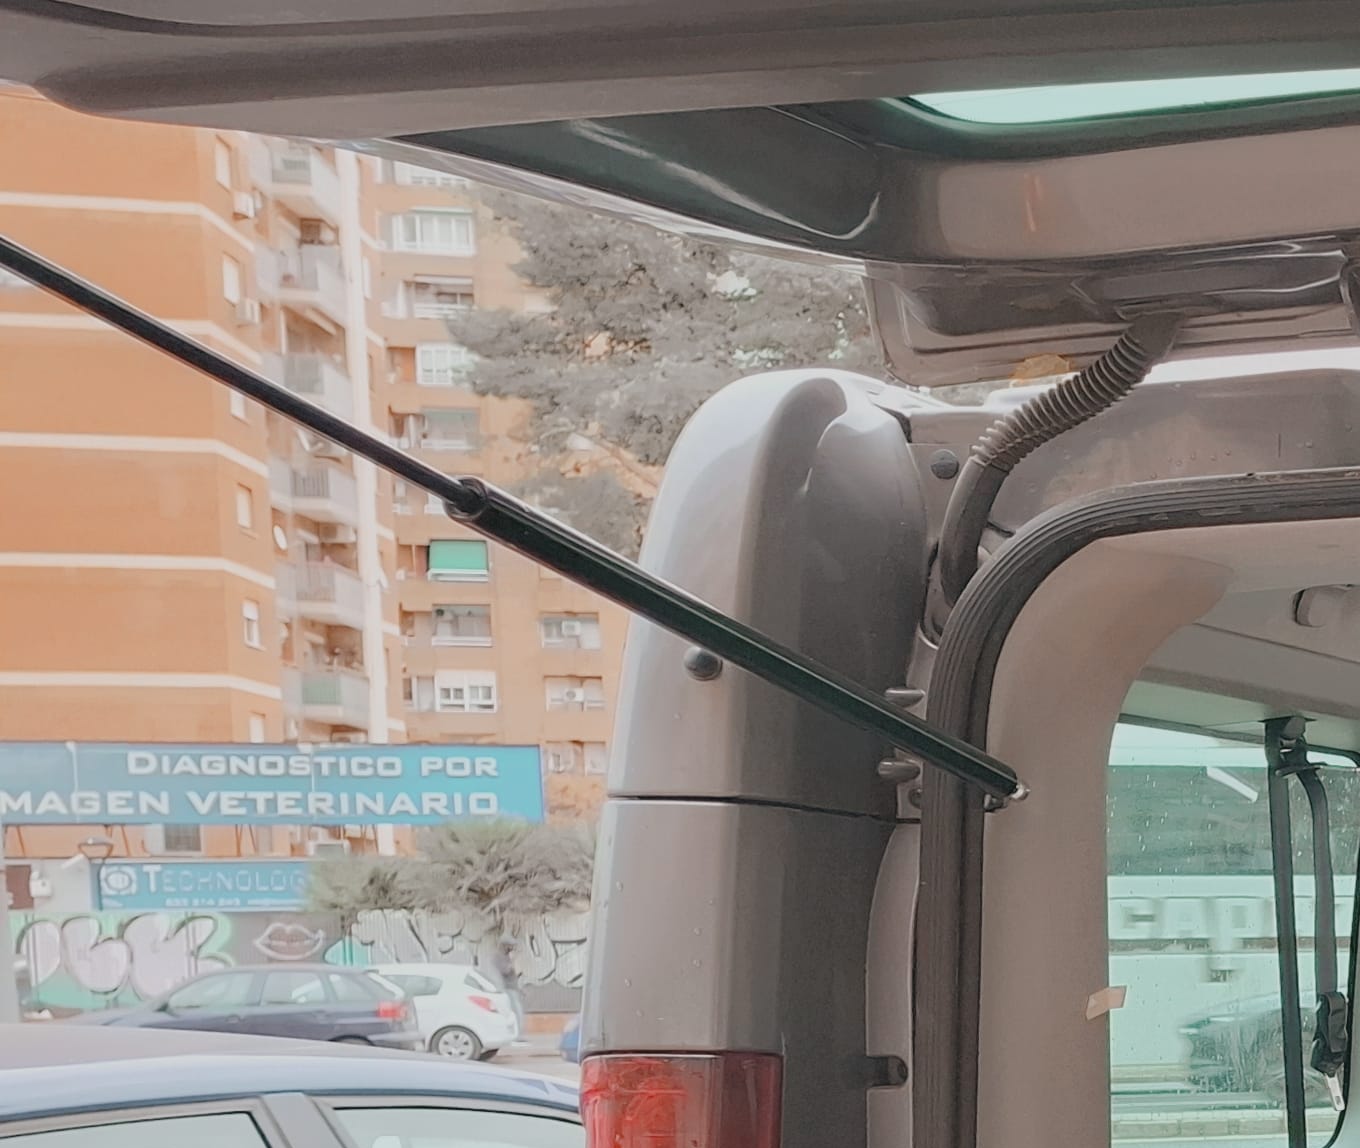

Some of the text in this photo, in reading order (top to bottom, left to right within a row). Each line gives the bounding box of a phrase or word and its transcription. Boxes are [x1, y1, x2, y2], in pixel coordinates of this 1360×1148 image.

[127, 750, 499, 777] DIAGNOSTICO POR
[0, 790, 499, 816] MAGEN VETERINARIO
[142, 863, 305, 893] TECHNOLOG
